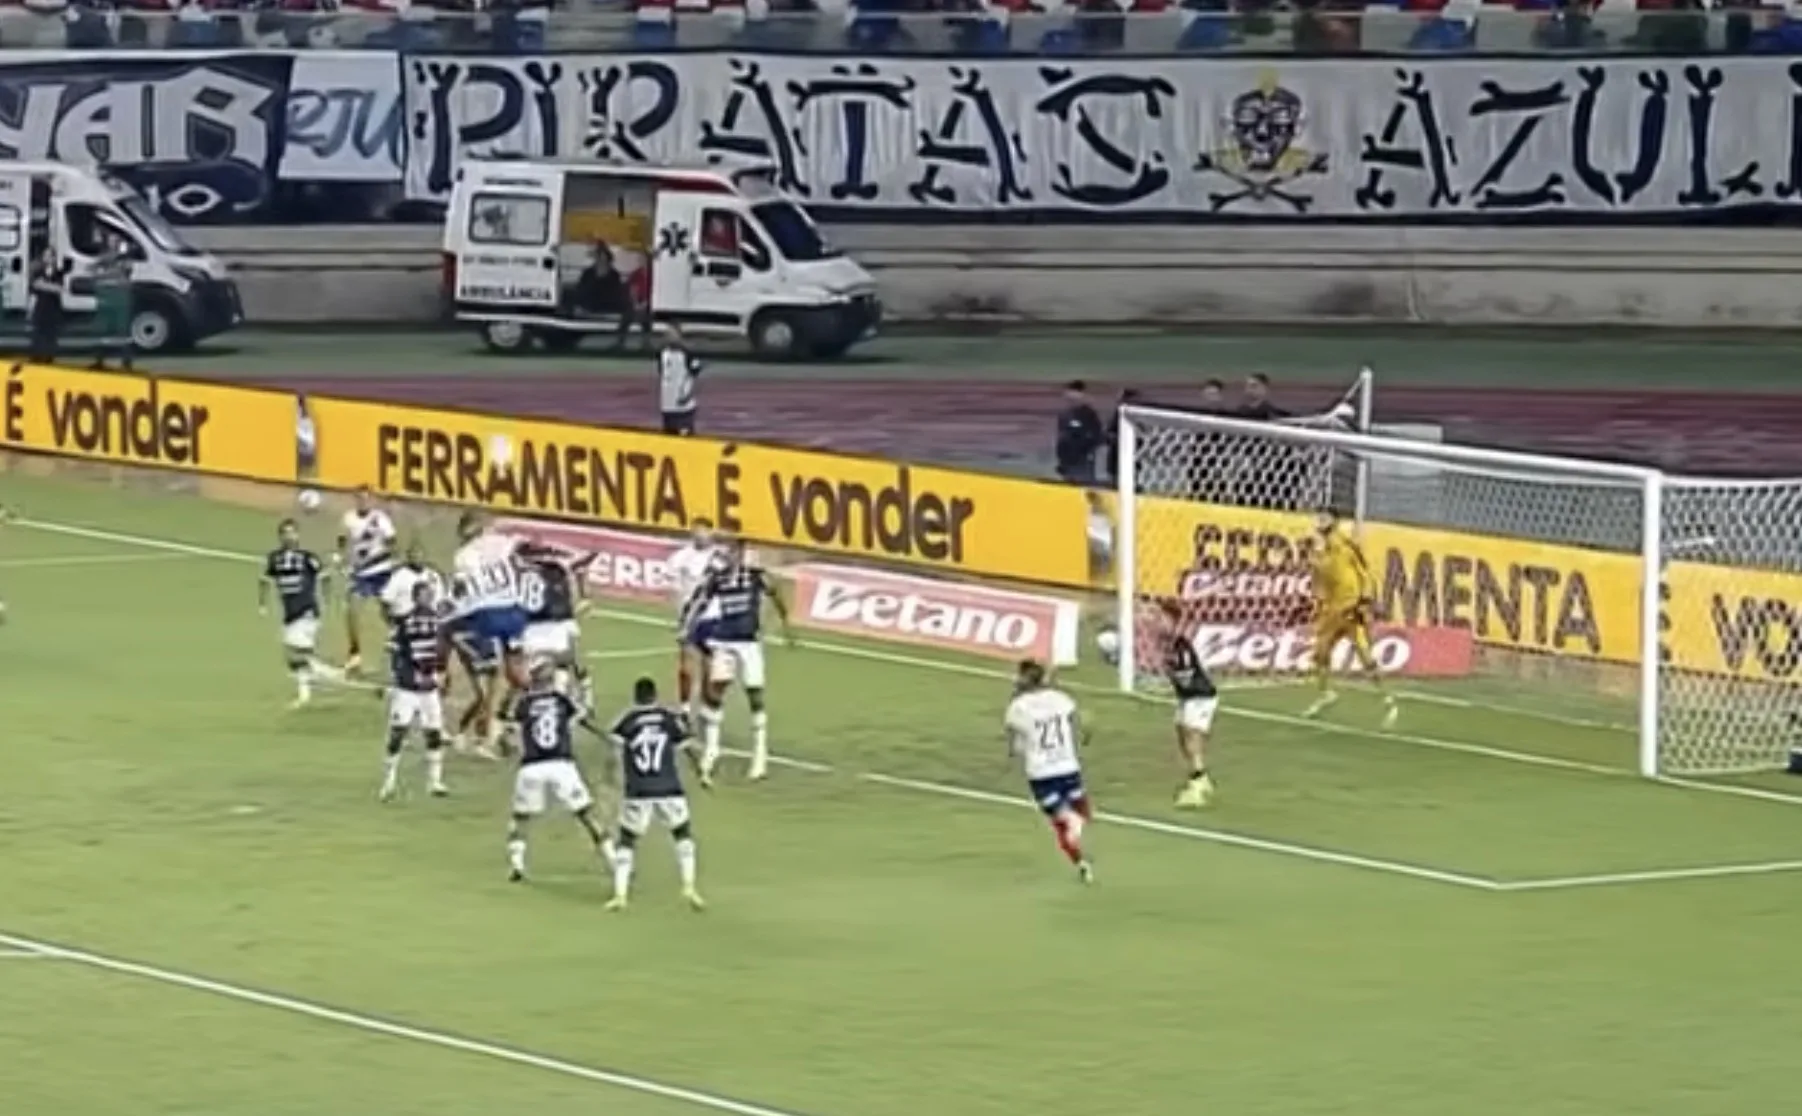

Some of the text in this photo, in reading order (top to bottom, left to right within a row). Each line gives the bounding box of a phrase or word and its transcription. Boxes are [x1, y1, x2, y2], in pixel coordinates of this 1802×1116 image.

[414, 60, 1176, 205] PIRATAS
[6, 362, 208, 464] É vonder
[378, 423, 975, 562] FERRAMENTA É vonder
[810, 576, 1039, 648] Betano
[631, 727, 668, 772] 37
